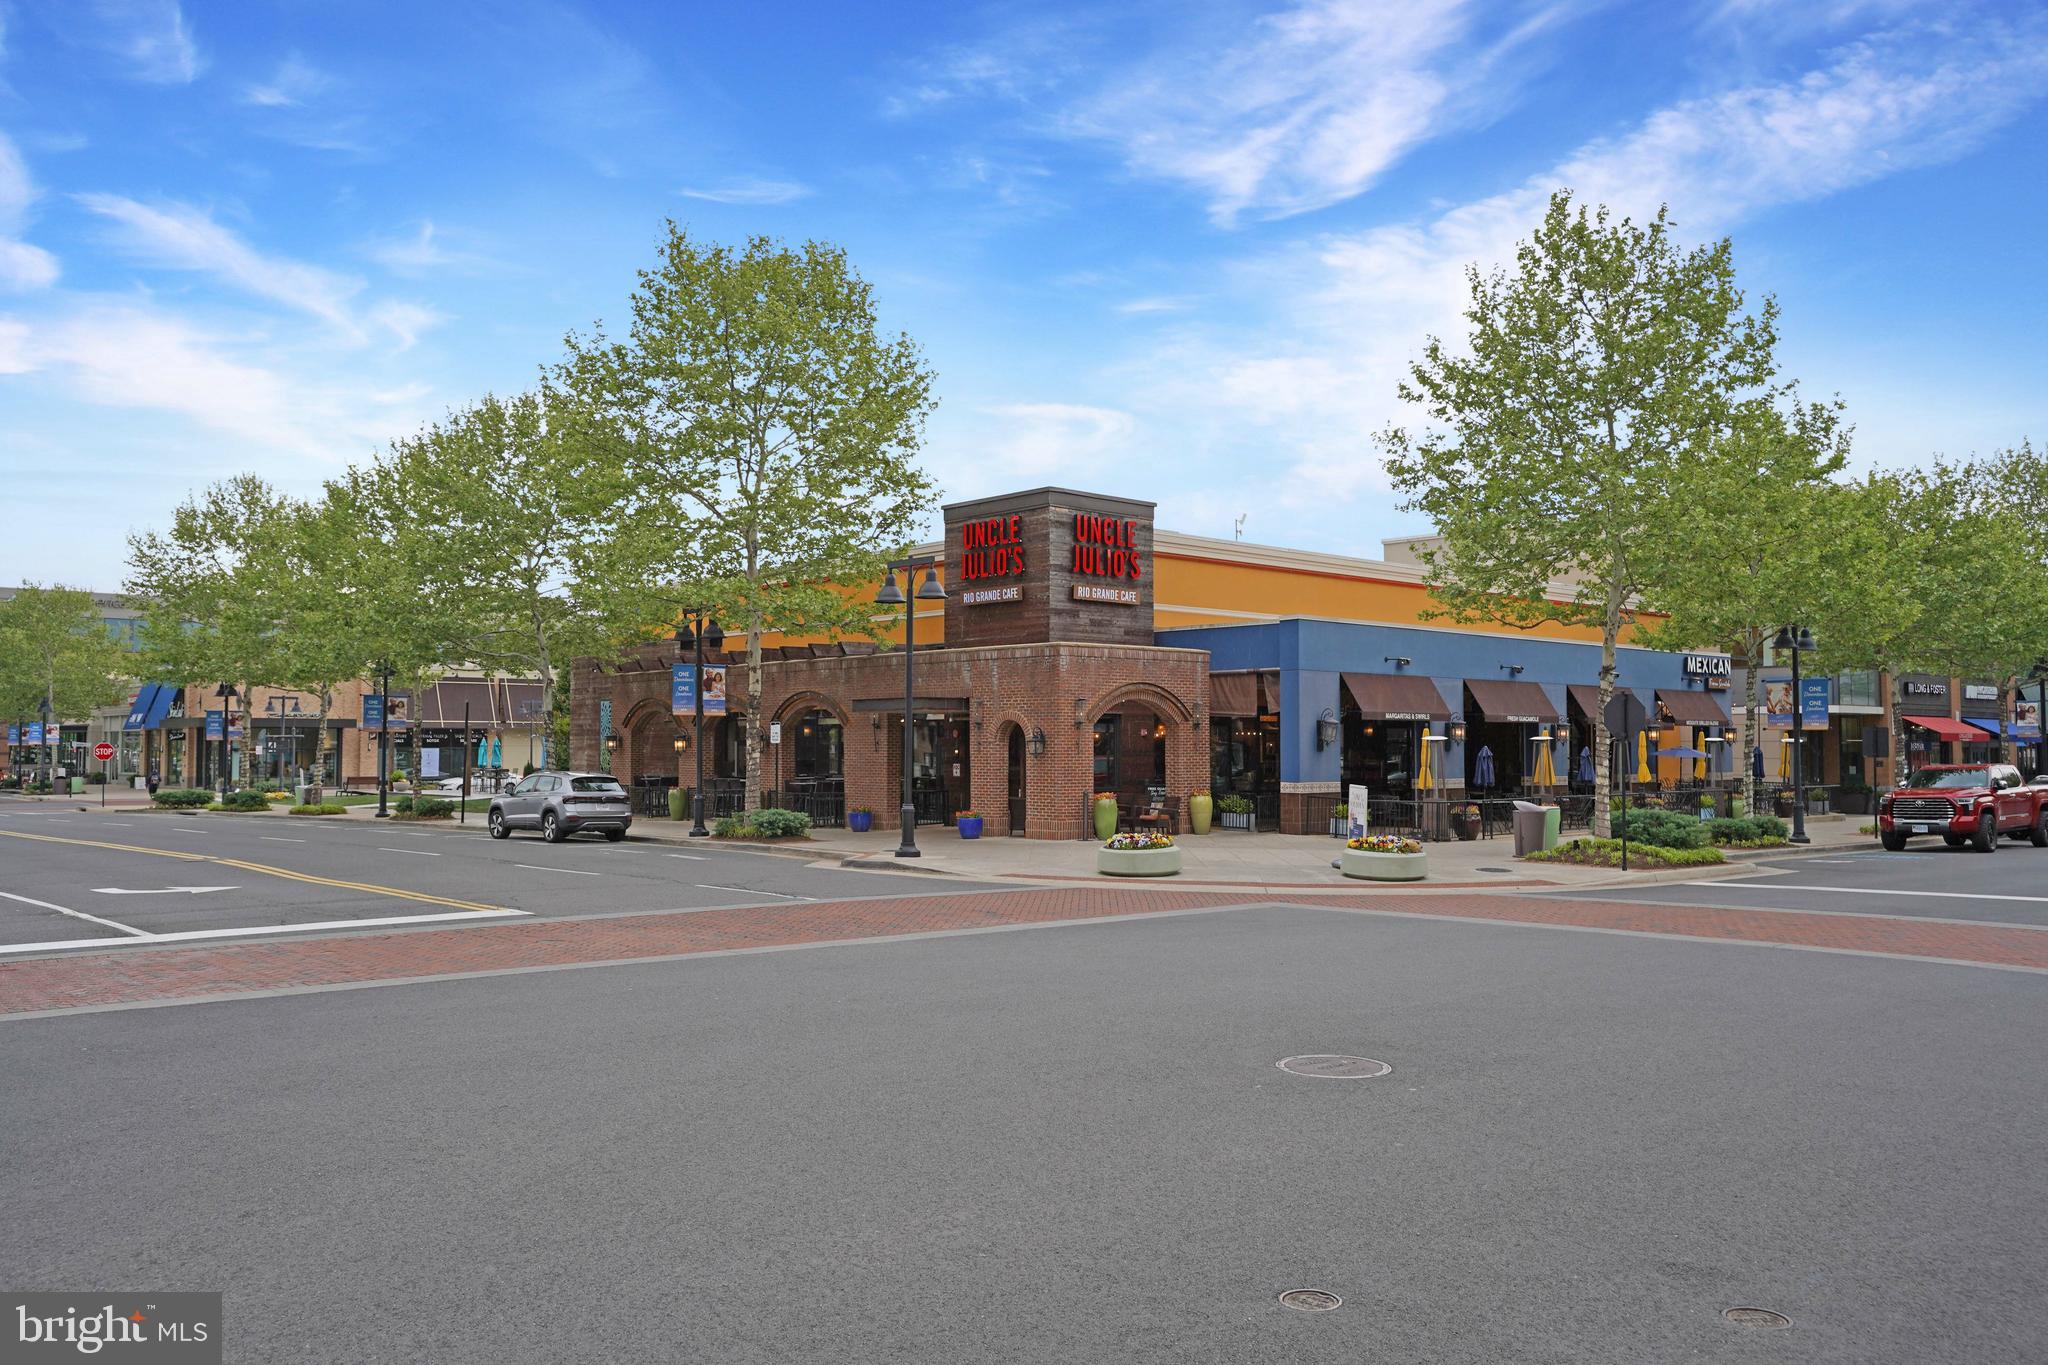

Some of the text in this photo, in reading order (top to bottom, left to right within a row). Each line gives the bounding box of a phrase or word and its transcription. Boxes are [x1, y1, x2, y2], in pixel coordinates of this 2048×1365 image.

[963, 515, 1020, 550] UNCLE
[1075, 512, 1137, 548] UNCLE
[960, 546, 1024, 580] JULIO'S
[1073, 544, 1141, 579] JULIO'S
[963, 587, 1018, 604] RIO GRANDE CAFE
[1077, 586, 1136, 602] RIO GRANDE CAFE
[1687, 656, 1731, 675] MEXICAN
[1914, 684, 1926, 693] LONG
[1930, 685, 1946, 695] FOSTER
[1385, 712, 1411, 720] MARGARITAS
[95, 747, 113, 756] STOP
